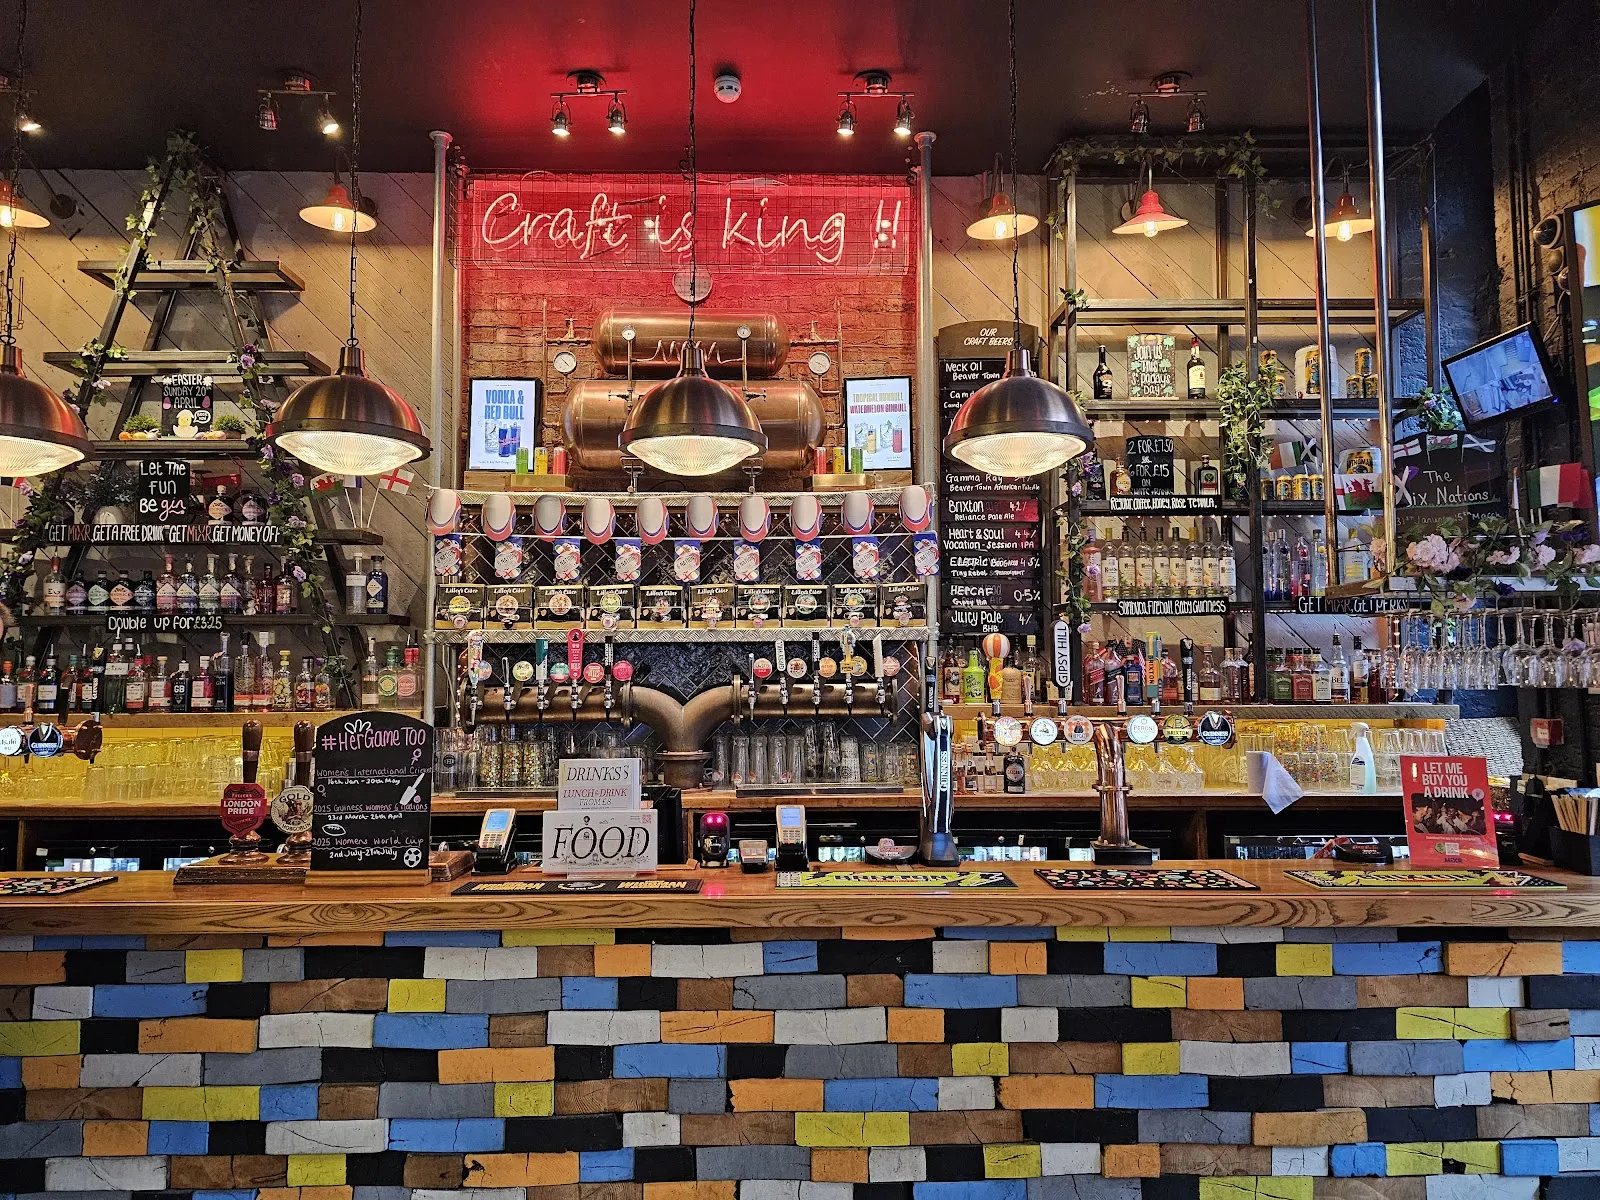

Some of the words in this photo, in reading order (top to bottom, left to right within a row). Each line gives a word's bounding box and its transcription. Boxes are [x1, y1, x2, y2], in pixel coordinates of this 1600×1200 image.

[482, 192, 632, 260] Craft
[653, 195, 696, 251] is
[722, 197, 847, 263] king
[980, 328, 997, 337] OUR
[963, 337, 987, 346] CRAFT
[988, 337, 1014, 346] BEERS
[945, 362, 967, 372] Neck
[970, 361, 982, 371] Oil
[172, 374, 203, 386] EASTER
[952, 372, 980, 381] Beaver
[163, 386, 193, 396] SUNDAY
[485, 389, 515, 404] VODKA
[517, 389, 524, 404] &
[853, 392, 878, 402] TROPICAL
[174, 397, 201, 408] APRIL
[485, 405, 502, 419] RED
[503, 405, 524, 420] BULL
[850, 404, 884, 414] WATERMELON
[1127, 441, 1136, 455] 2
[1138, 440, 1153, 454] FOR
[140, 462, 163, 475] Let
[165, 461, 186, 476] The
[1135, 465, 1152, 478] FOR
[1152, 464, 1170, 477] £15
[945, 474, 980, 483] Gamma
[985, 474, 1003, 485] Ray
[1423, 470, 1452, 483] The
[949, 484, 974, 492] Beaver
[1437, 485, 1489, 504] Nations
[140, 498, 158, 513] Be
[159, 497, 186, 521] gin
[948, 500, 984, 513] Brixton
[954, 513, 986, 521] Reliance
[49, 525, 67, 541] GET
[93, 525, 111, 541] GET
[111, 525, 119, 541] A
[120, 525, 140, 541] FREE
[141, 525, 164, 542] DRINK
[169, 525, 187, 542] GET
[213, 525, 231, 542] GET
[232, 526, 262, 542] MONEY
[948, 528, 974, 539] Heart
[976, 528, 982, 539] &
[983, 528, 1004, 540] Soul
[943, 540, 980, 550] Vocation
[986, 541, 1017, 549] Session
[1020, 541, 1034, 549] IPA
[1298, 596, 1322, 613] GET
[108, 616, 147, 630] Double
[153, 617, 170, 630] up
[173, 616, 194, 630] for
[951, 610, 978, 626] Juicy
[981, 610, 1003, 624] Pale
[1057, 626, 1067, 649] HILL
[1058, 652, 1068, 684] GIPSY
[173, 685, 185, 693] GB
[354, 767, 407, 776] International
[567, 766, 622, 781] DRINKS
[940, 751, 949, 792] GUINNESS
[1424, 762, 1442, 774] LET
[1445, 762, 1463, 774] ME
[1422, 774, 1444, 786] BUY
[1446, 775, 1468, 786] YOU
[279, 793, 311, 803] GOLD
[563, 788, 595, 798] LUNCH
[600, 788, 627, 797] DRINK
[1424, 786, 1432, 798] A
[1434, 787, 1469, 799] DRINK
[223, 800, 261, 808] LONDON
[579, 798, 600, 806] FROM
[312, 838, 330, 846] 2025
[405, 837, 424, 846] Cup
[549, 826, 650, 859] FOOD
